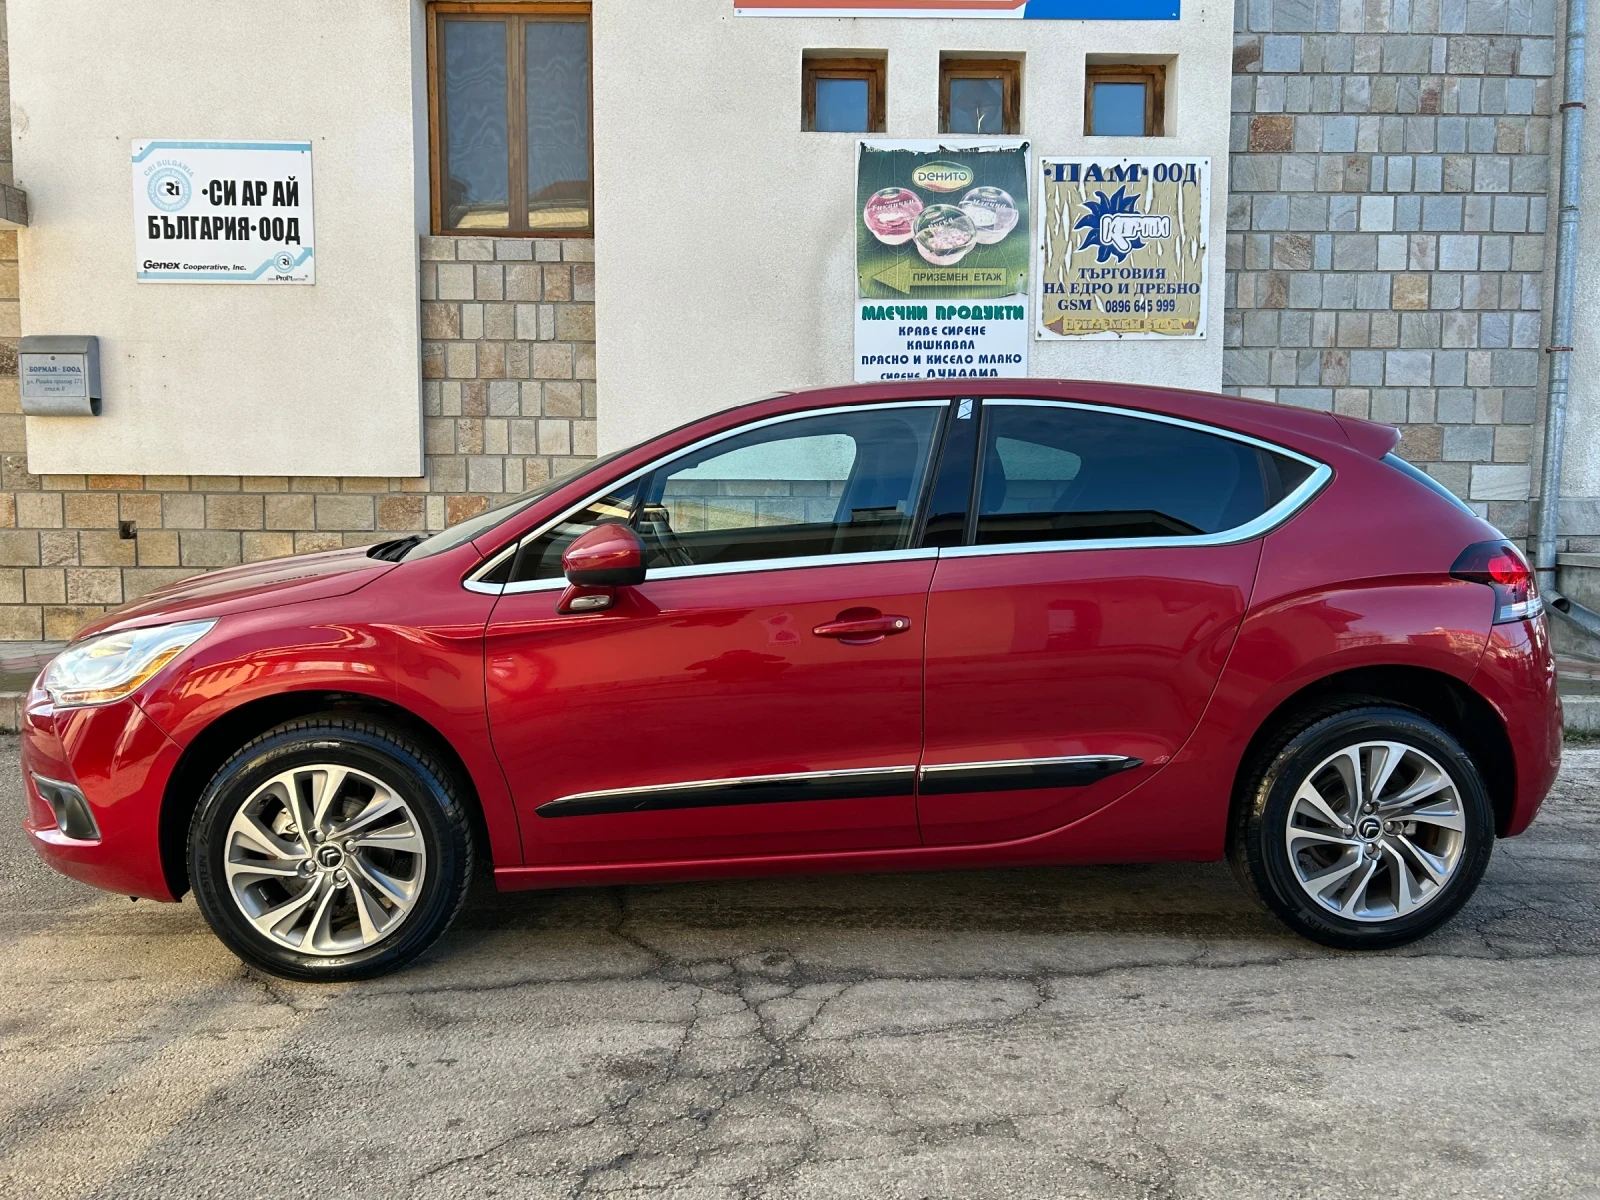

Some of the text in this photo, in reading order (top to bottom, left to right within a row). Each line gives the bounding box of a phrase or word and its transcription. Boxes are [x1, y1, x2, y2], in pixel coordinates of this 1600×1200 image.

[143, 159, 194, 177] CRI BULGARIA
[1053, 163, 1197, 187] ПАМ ООД
[209, 176, 299, 207] СИ АР АЙ
[147, 215, 301, 245] БЪЛГАРИЯ ООД
[143, 260, 181, 270] Genex
[913, 272, 1002, 281] ПРИЗЕМЕН ЕТАЖ
[1078, 268, 1166, 279] ТЪРГОВИЯ
[1044, 283, 1200, 296] НА ЕДРО И ДРЕБНО
[862, 305, 1024, 320] МЛЕЧНИ ПРОДУКТИ
[1058, 299, 1175, 313] GSM 0896 645 999
[898, 326, 986, 336] КРАВЕ СИРЕНЕ
[907, 340, 975, 350] КАШКАВАЛ
[861, 354, 1022, 365] ПРЯСНО И КИСЕЛО МЛАКО
